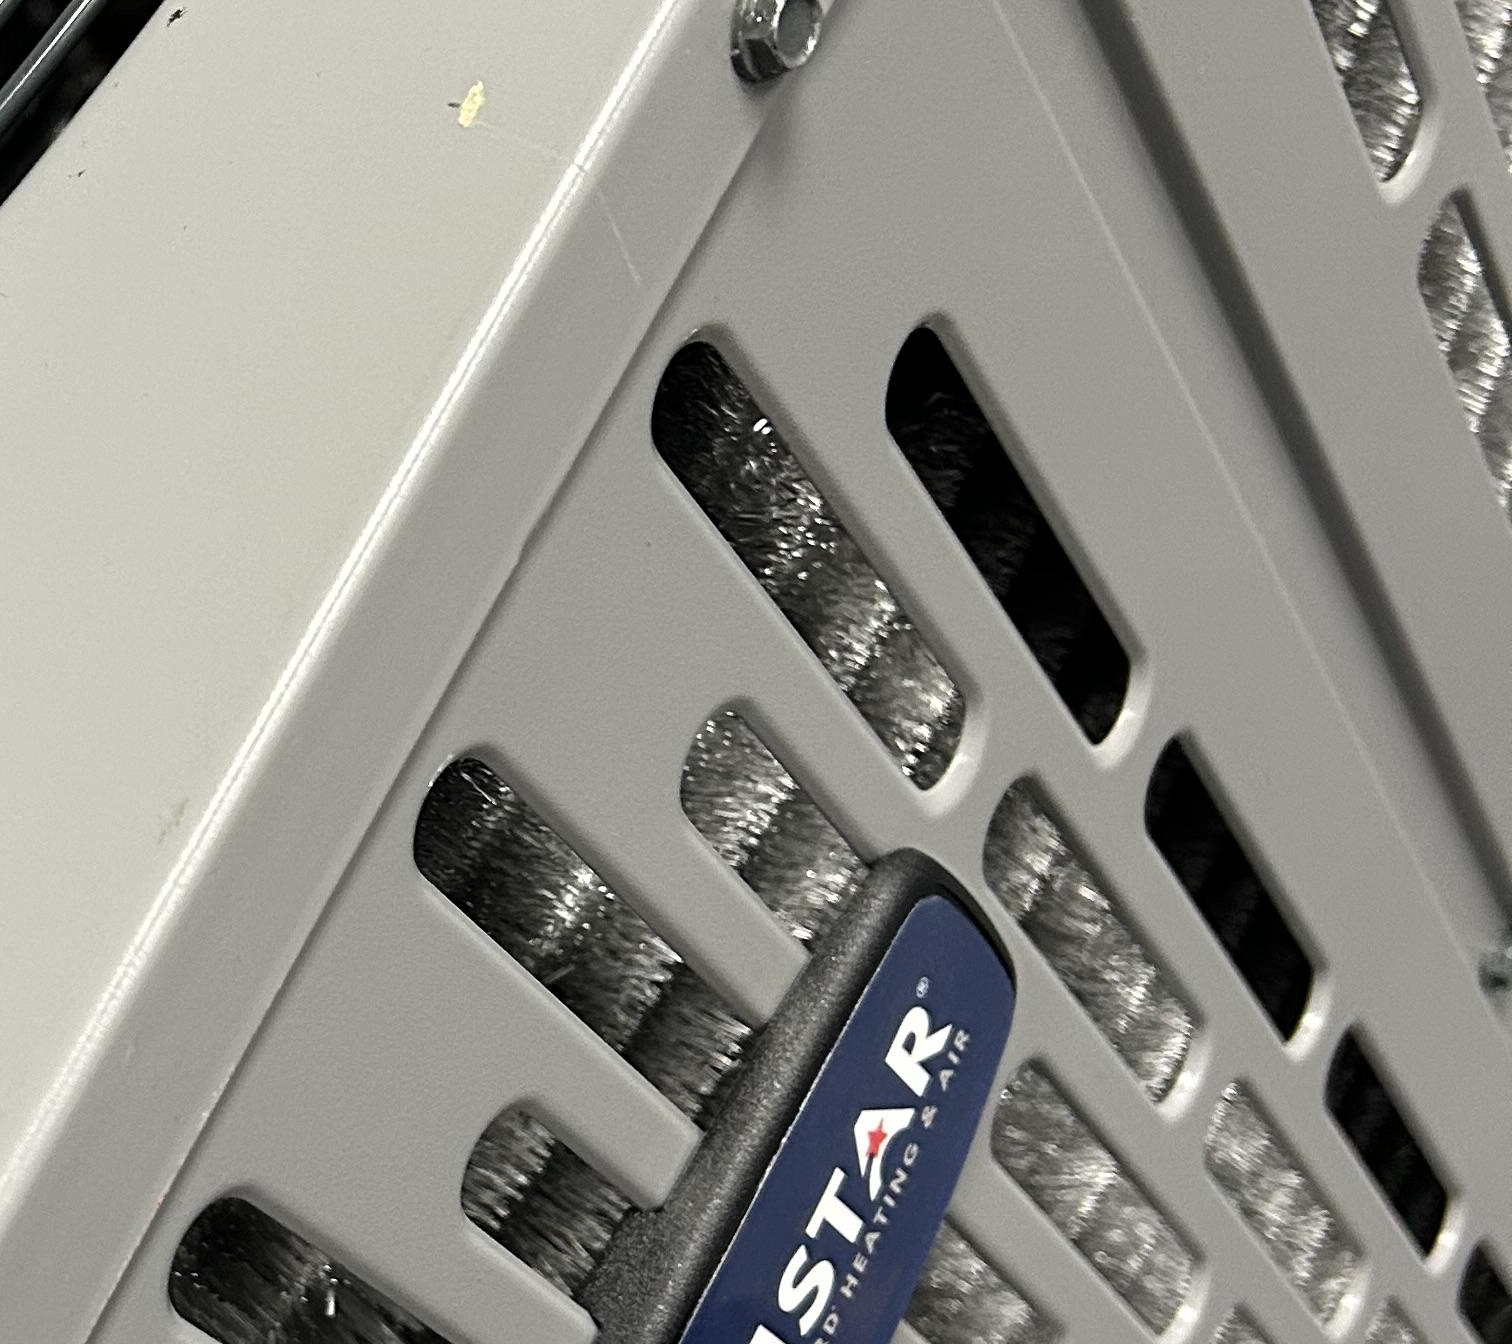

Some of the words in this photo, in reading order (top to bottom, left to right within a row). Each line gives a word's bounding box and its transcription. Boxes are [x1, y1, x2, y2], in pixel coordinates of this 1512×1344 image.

[838, 1141, 920, 1300] HEATING
[920, 1104, 939, 1130] &
[937, 1028, 972, 1093] AIR
